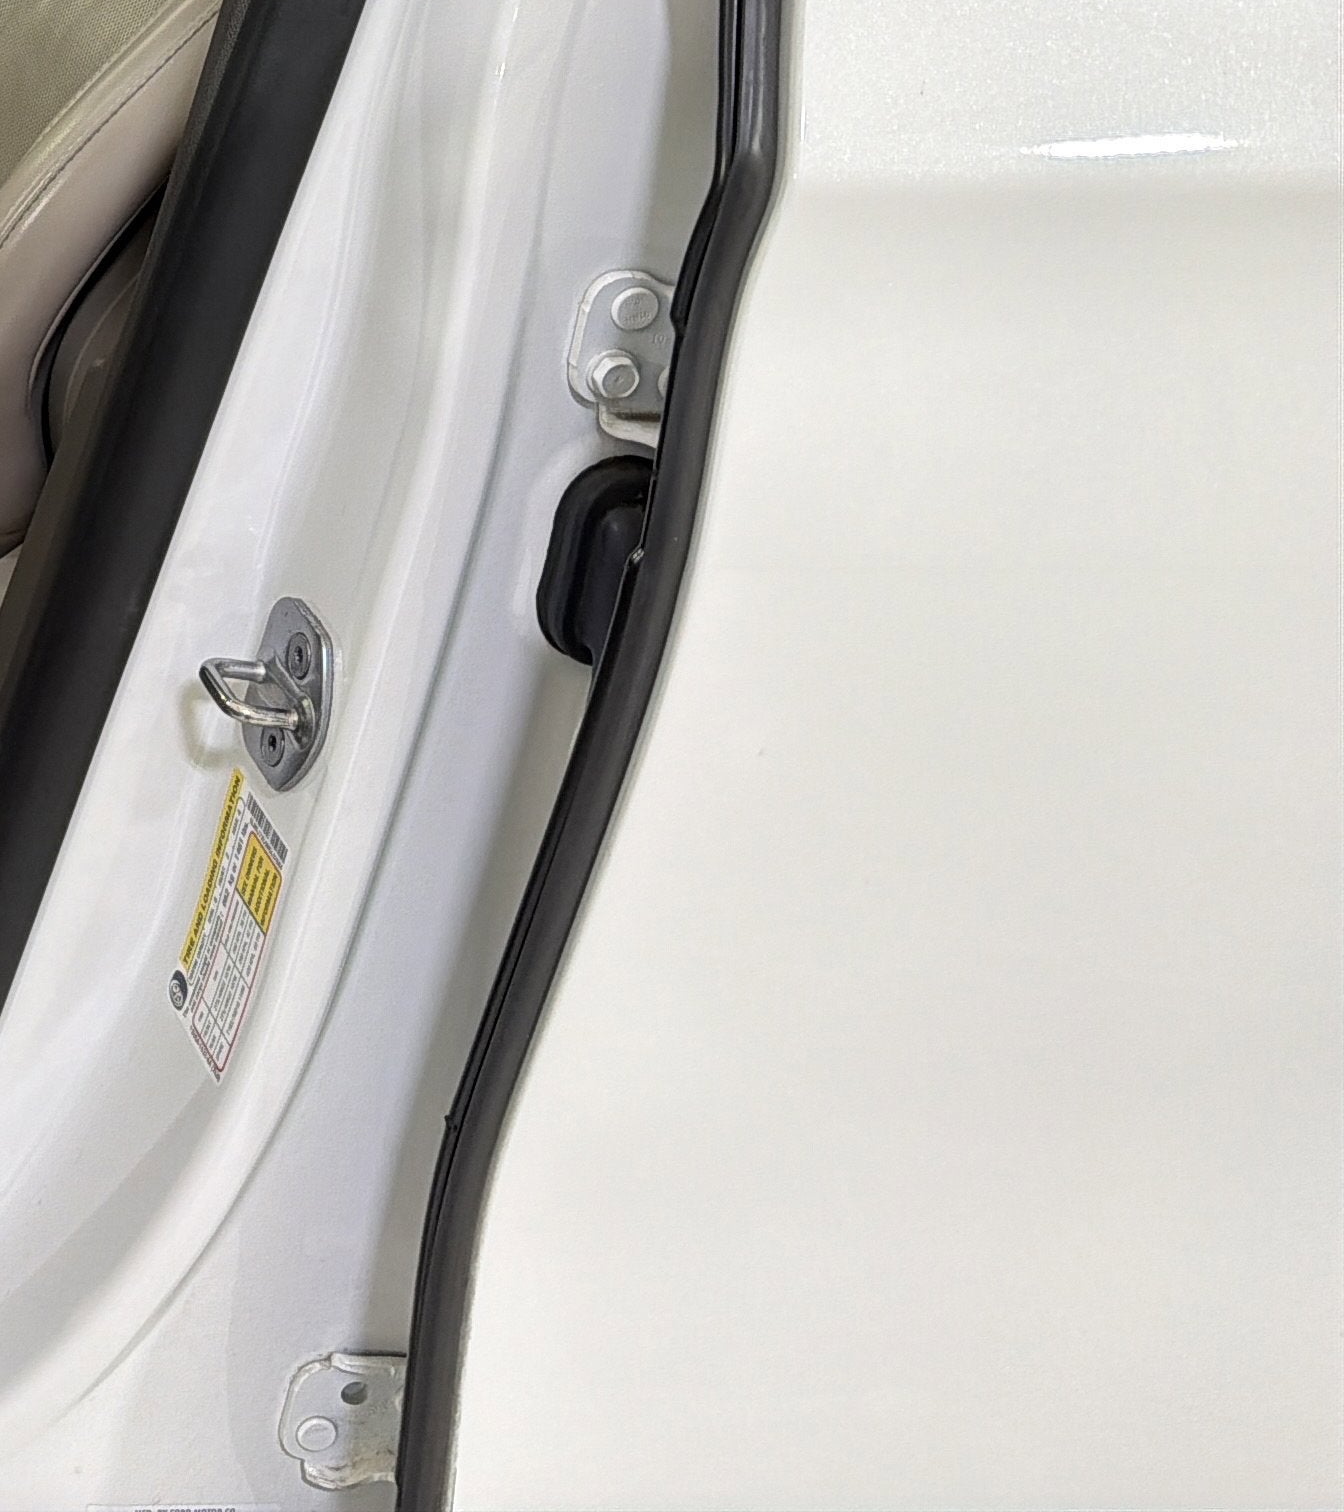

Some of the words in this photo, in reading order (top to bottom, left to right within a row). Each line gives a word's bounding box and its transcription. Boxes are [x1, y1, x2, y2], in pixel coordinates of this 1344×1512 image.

[183, 934, 195, 967] TIRE
[200, 857, 218, 912] LOADING
[215, 774, 240, 860] INFORMATION
